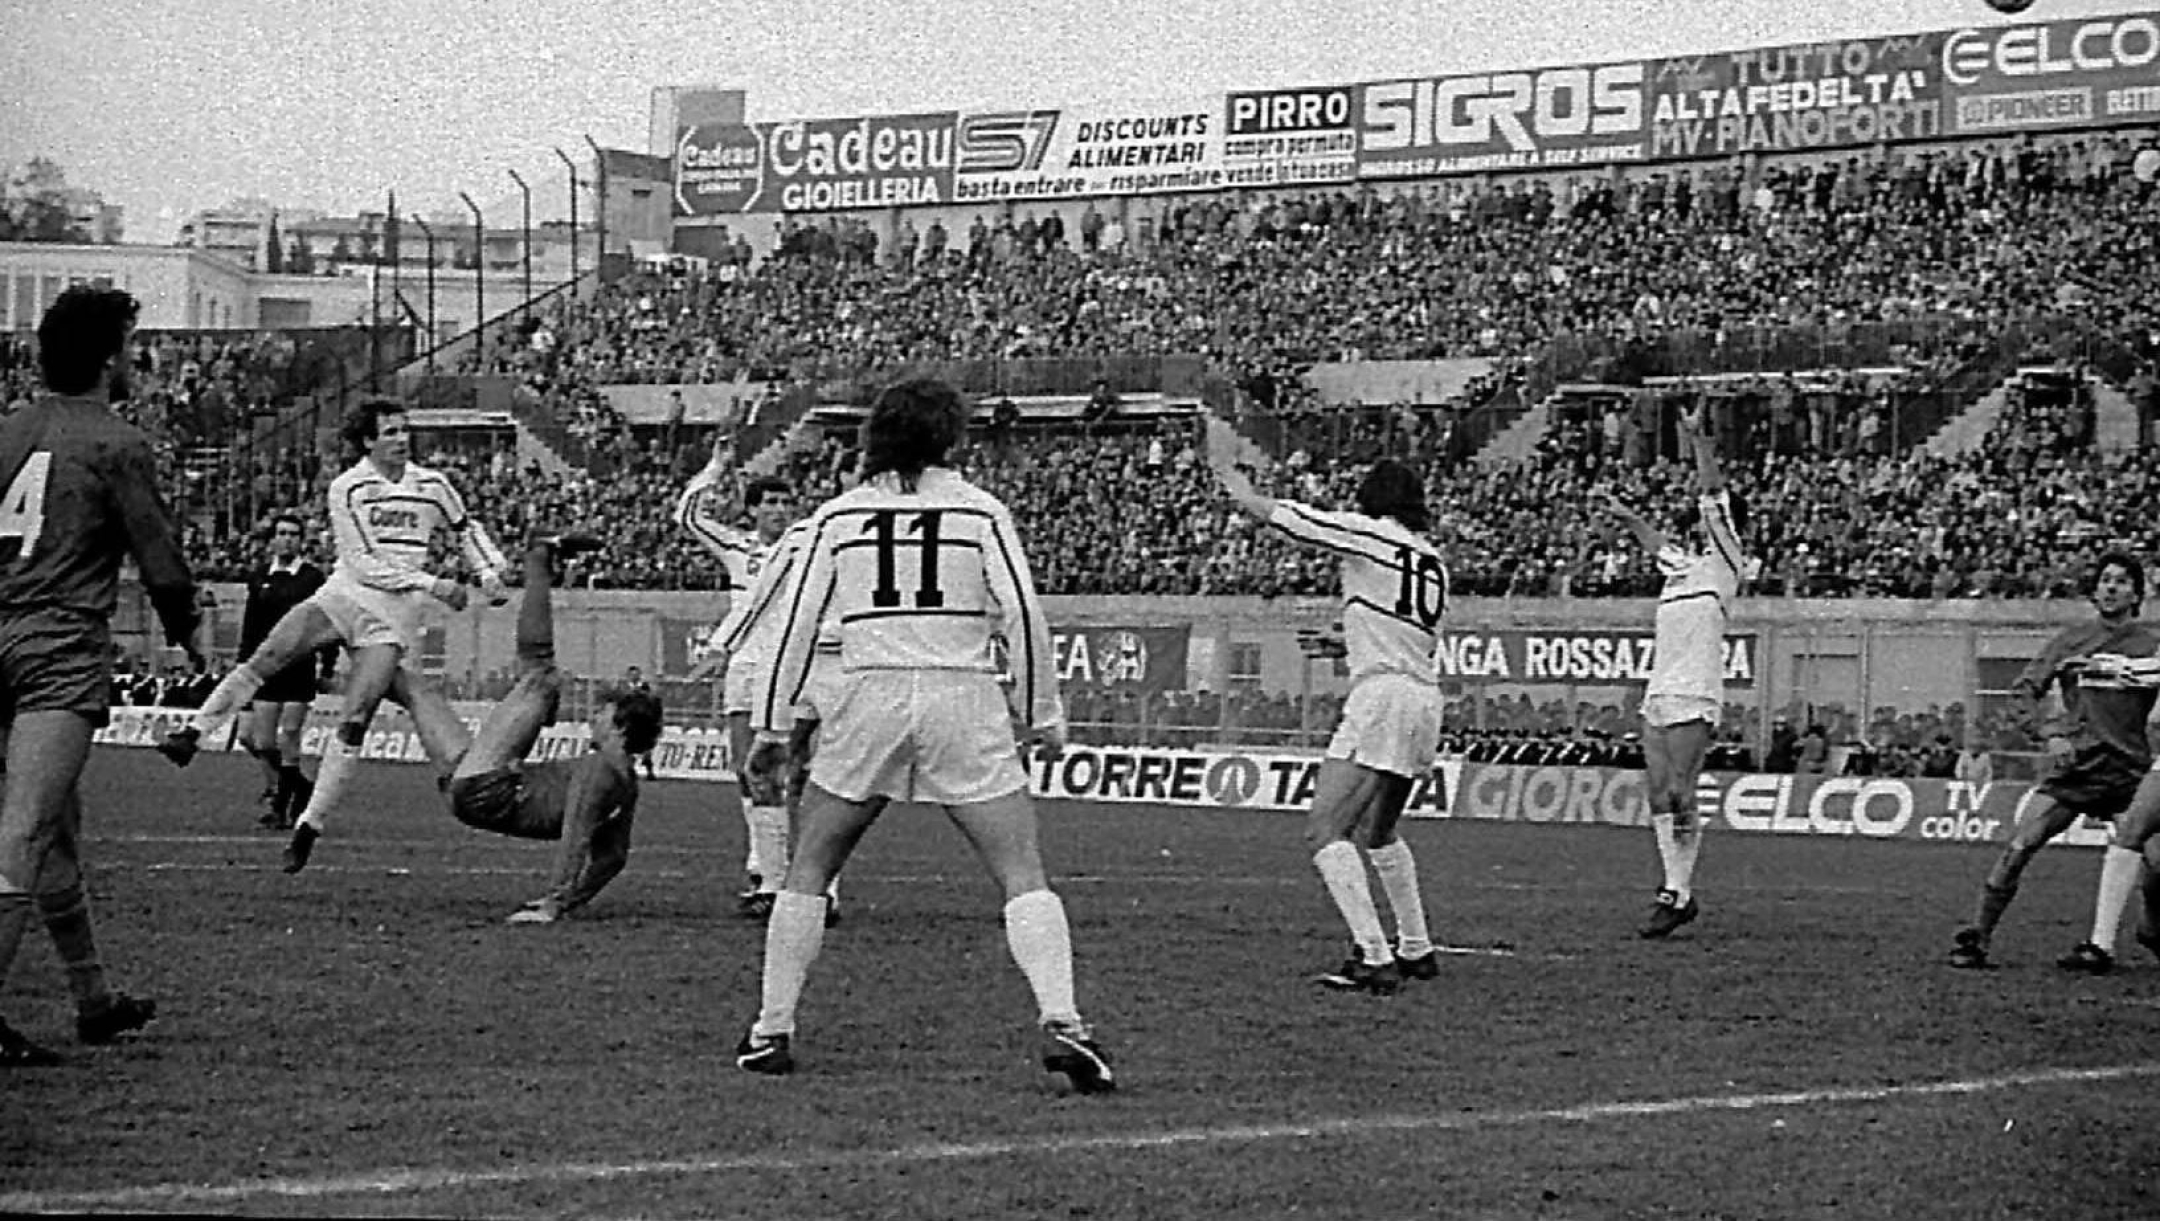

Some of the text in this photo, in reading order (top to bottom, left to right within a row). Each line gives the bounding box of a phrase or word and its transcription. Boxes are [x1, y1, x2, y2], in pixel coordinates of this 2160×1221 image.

[1730, 42, 1869, 87] TUTTO
[1995, 18, 2160, 76] ELCO
[1077, 114, 1209, 143] DISCOUNTS
[1233, 91, 1348, 131] PIRRO
[1363, 63, 1643, 151] SIGROS
[769, 118, 953, 176] Cadeau
[1068, 141, 1206, 169] ALIMENTARI
[783, 177, 940, 210] GIOIELLERIA
[0, 451, 52, 556] 4
[861, 511, 943, 607] 11
[1395, 545, 1444, 627] 10
[1034, 748, 1208, 800] TORRE
[1945, 780, 1993, 810] TV
[1724, 774, 1913, 835] ELCO
[1919, 809, 2001, 841] color
